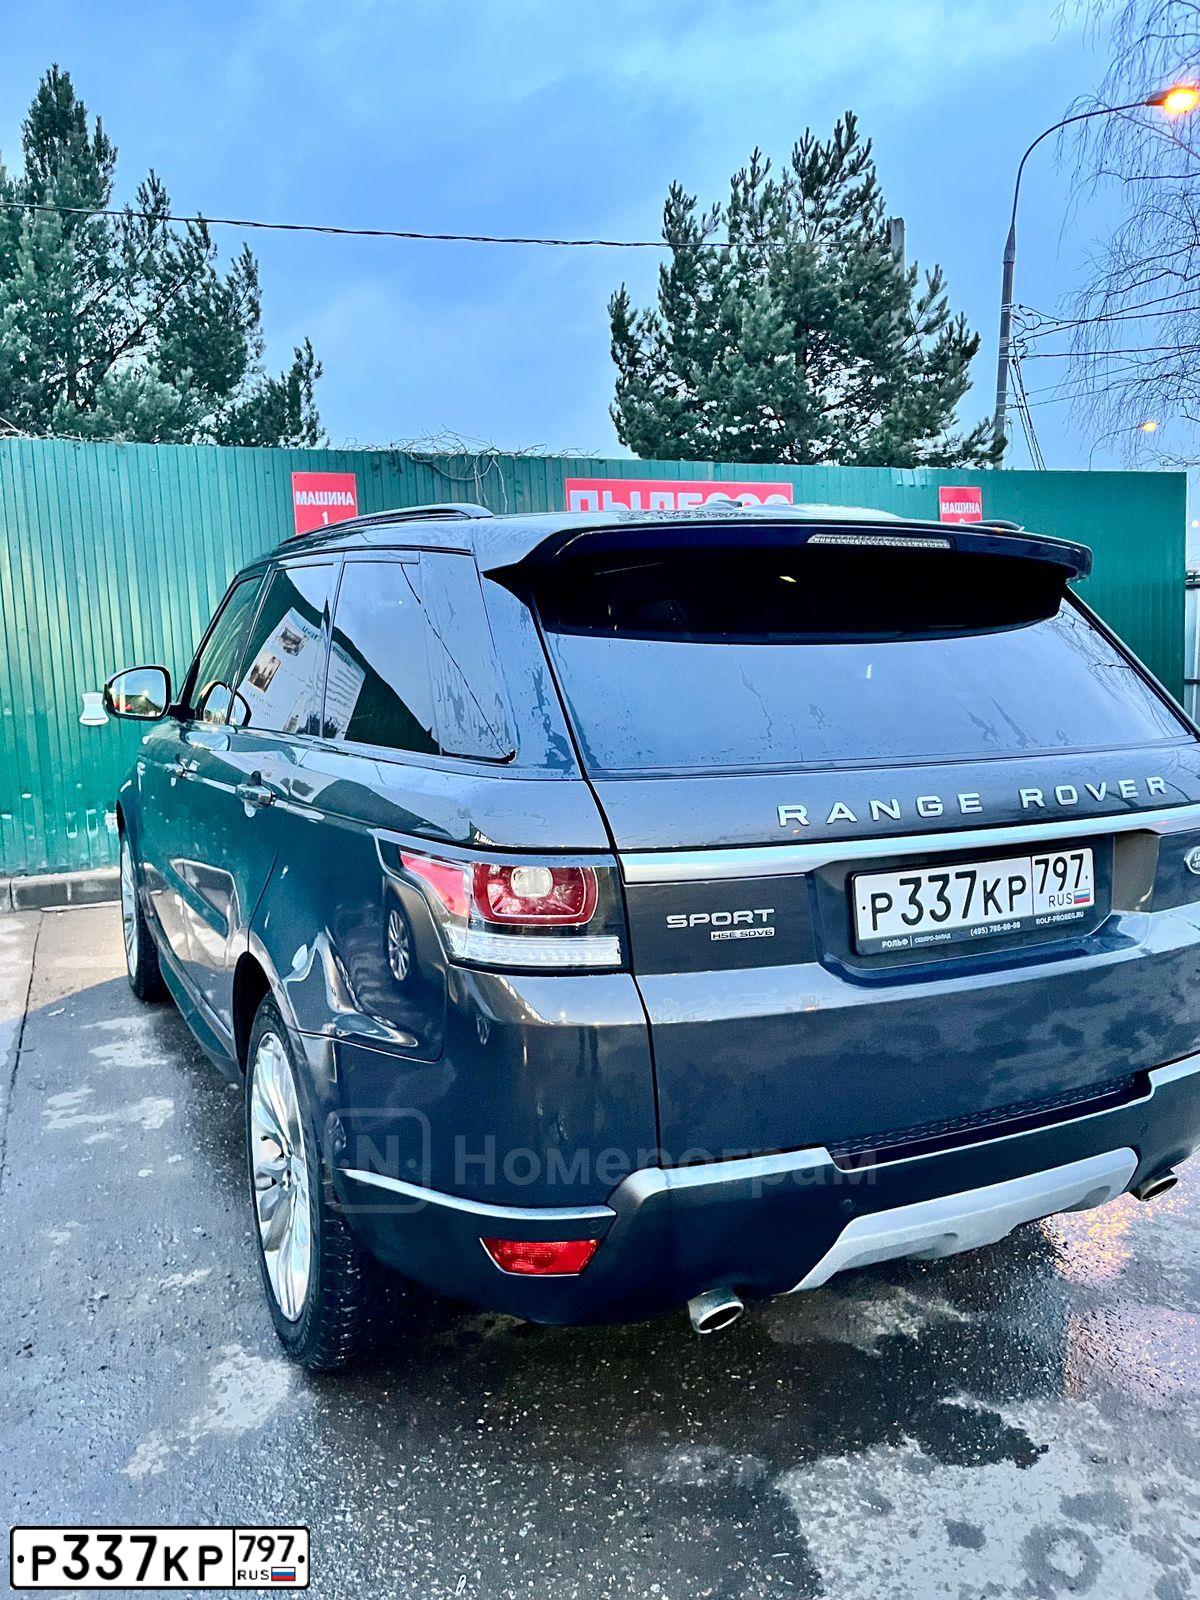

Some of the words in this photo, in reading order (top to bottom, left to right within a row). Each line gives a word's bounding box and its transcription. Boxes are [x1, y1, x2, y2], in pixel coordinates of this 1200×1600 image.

[295, 490, 355, 506] МАШИНА
[941, 501, 981, 514] МАШИНА
[321, 510, 329, 525] 1
[776, 792, 984, 827] RANGE
[1018, 775, 1168, 809] ROVER
[1033, 853, 1085, 895] 797
[870, 870, 1027, 931] Р337КР
[1048, 892, 1073, 908] RUS
[665, 908, 775, 929] SPORT
[712, 931, 738, 940] HSE
[739, 928, 774, 939] SDV6
[970, 925, 989, 937] (495)
[881, 937, 909, 949] РОЛЬФ
